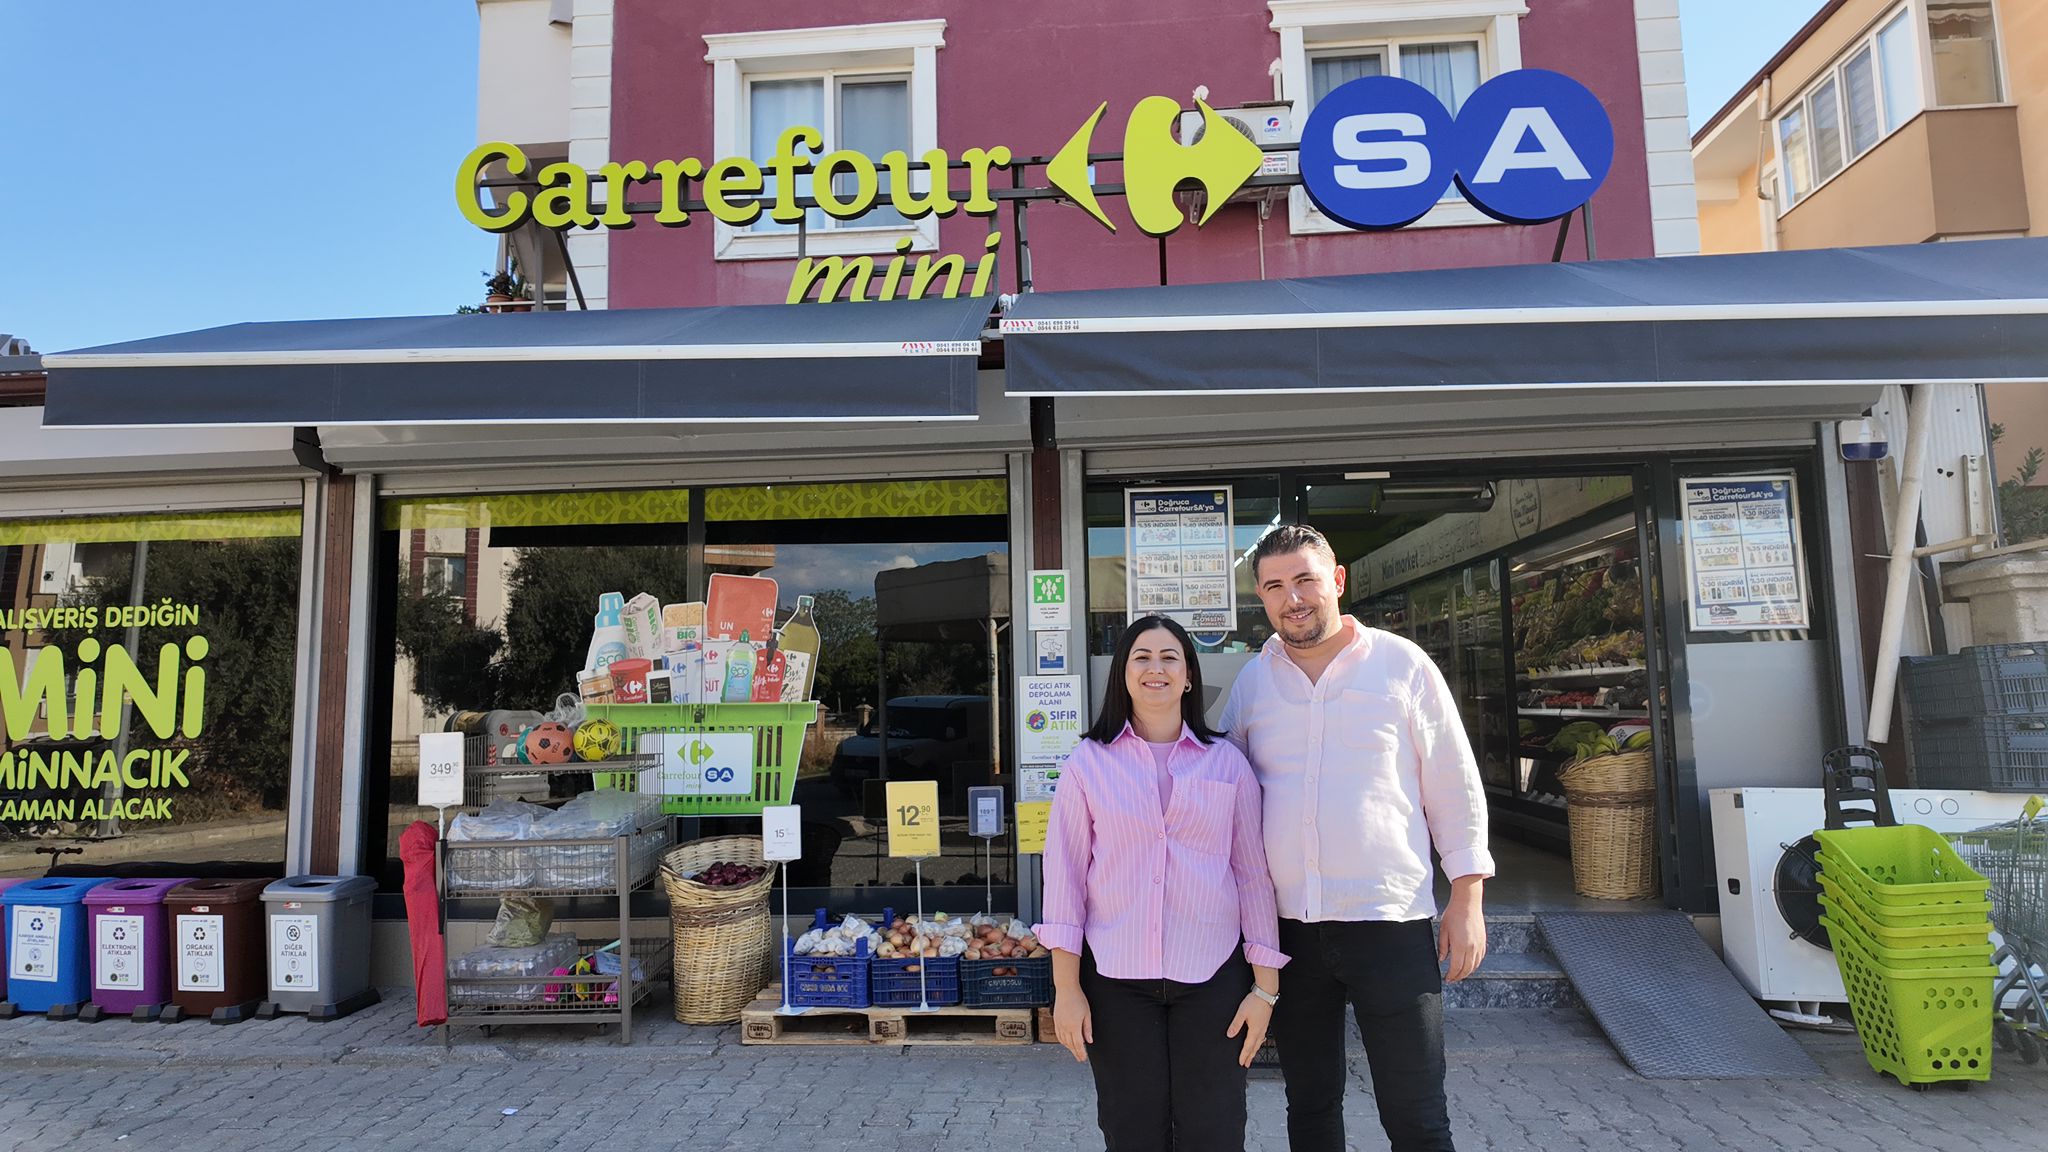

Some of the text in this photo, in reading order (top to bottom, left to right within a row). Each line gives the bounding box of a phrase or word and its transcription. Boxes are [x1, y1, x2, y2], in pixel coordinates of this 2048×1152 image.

[455, 107, 1592, 230] Carrefour SA
[785, 231, 1002, 304] mini
[1712, 491, 1774, 500] CarrefourSA'ya
[720, 622, 734, 630] UN
[676, 631, 696, 639] BIO
[596, 654, 624, 667] eco
[731, 666, 749, 678] eco
[1050, 710, 1077, 720] SIFIR
[1051, 721, 1077, 731] ATIK
[430, 763, 451, 775] 349
[657, 770, 732, 780] Carrefour SA
[0, 798, 173, 822] AMAN ALACAK
[774, 829, 784, 838] 15
